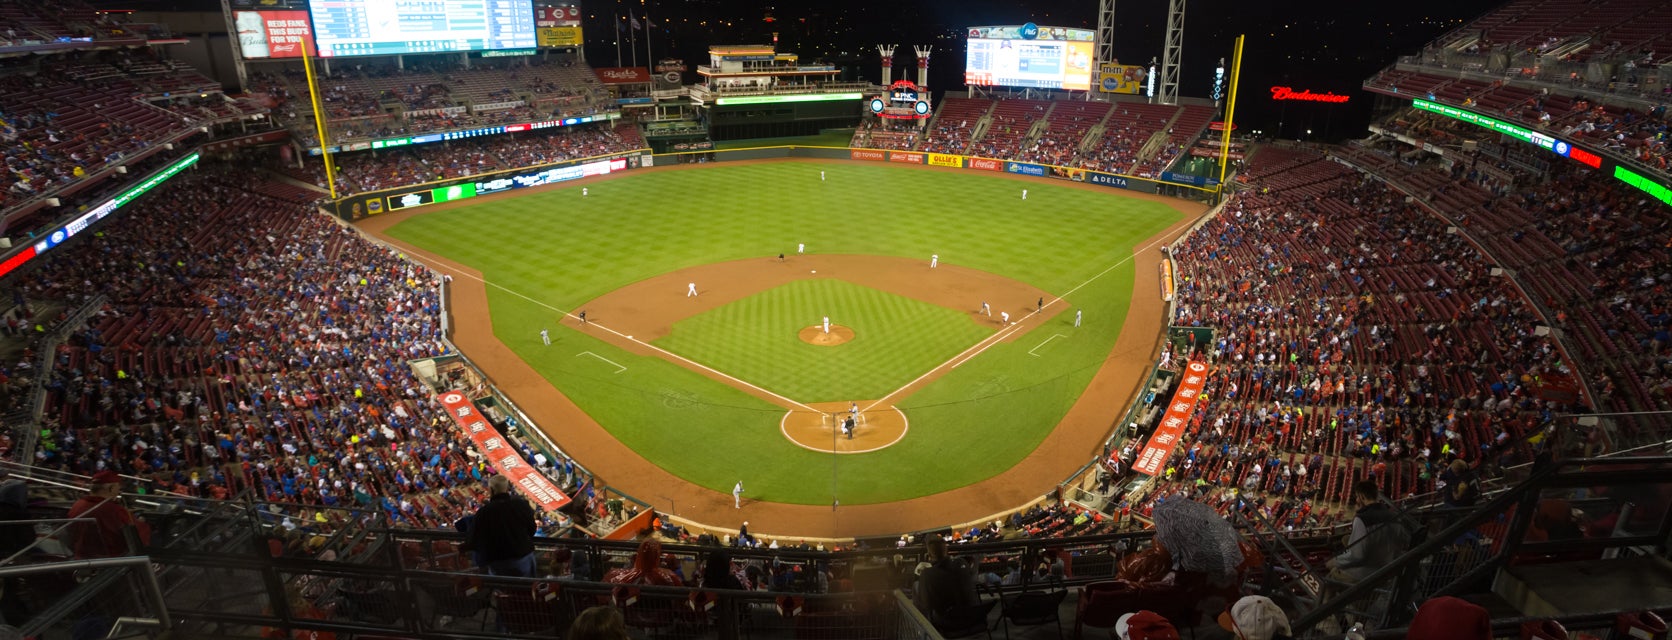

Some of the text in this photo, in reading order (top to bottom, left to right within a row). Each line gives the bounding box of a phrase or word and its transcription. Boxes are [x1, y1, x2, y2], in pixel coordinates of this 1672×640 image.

[267, 20, 287, 28] REDS
[603, 69, 638, 79] Reds
[1270, 86, 1350, 102] Budweiser
[934, 155, 958, 164] OLLIE'S
[1100, 176, 1127, 186] DELTA
[519, 477, 553, 505] CHAMPIONS
